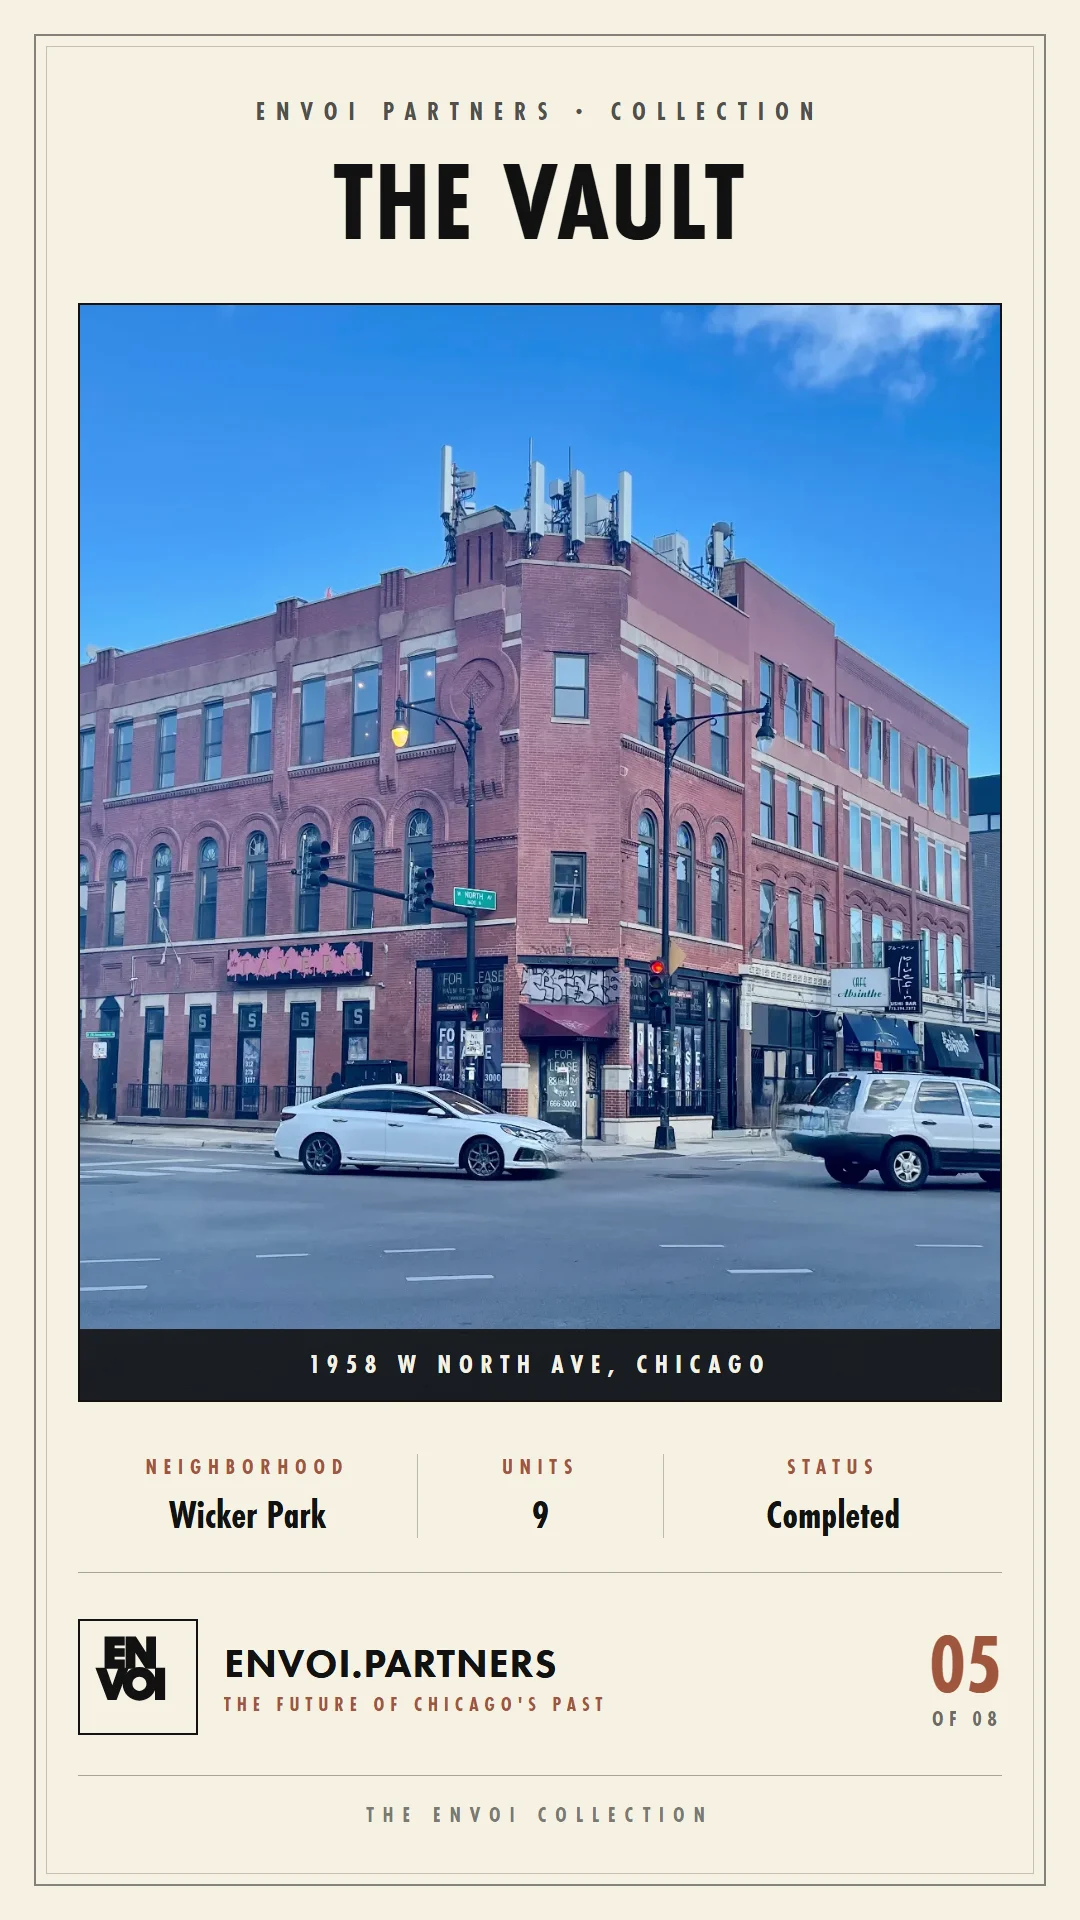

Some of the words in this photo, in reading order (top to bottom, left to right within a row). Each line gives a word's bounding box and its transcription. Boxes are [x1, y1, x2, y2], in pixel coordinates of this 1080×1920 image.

[465, 892, 484, 900] NORTH
[443, 973, 462, 985] FOR
[475, 971, 504, 984] EASE
[853, 977, 866, 987] CAFE
[838, 989, 882, 998] Absinthe
[199, 1014, 207, 1028] S
[248, 1013, 257, 1028] S
[301, 1012, 310, 1027] S
[354, 1008, 363, 1024] S
[555, 1050, 573, 1059] FOR
[549, 1062, 578, 1072] LEASE
[485, 1074, 501, 1082] 3000
